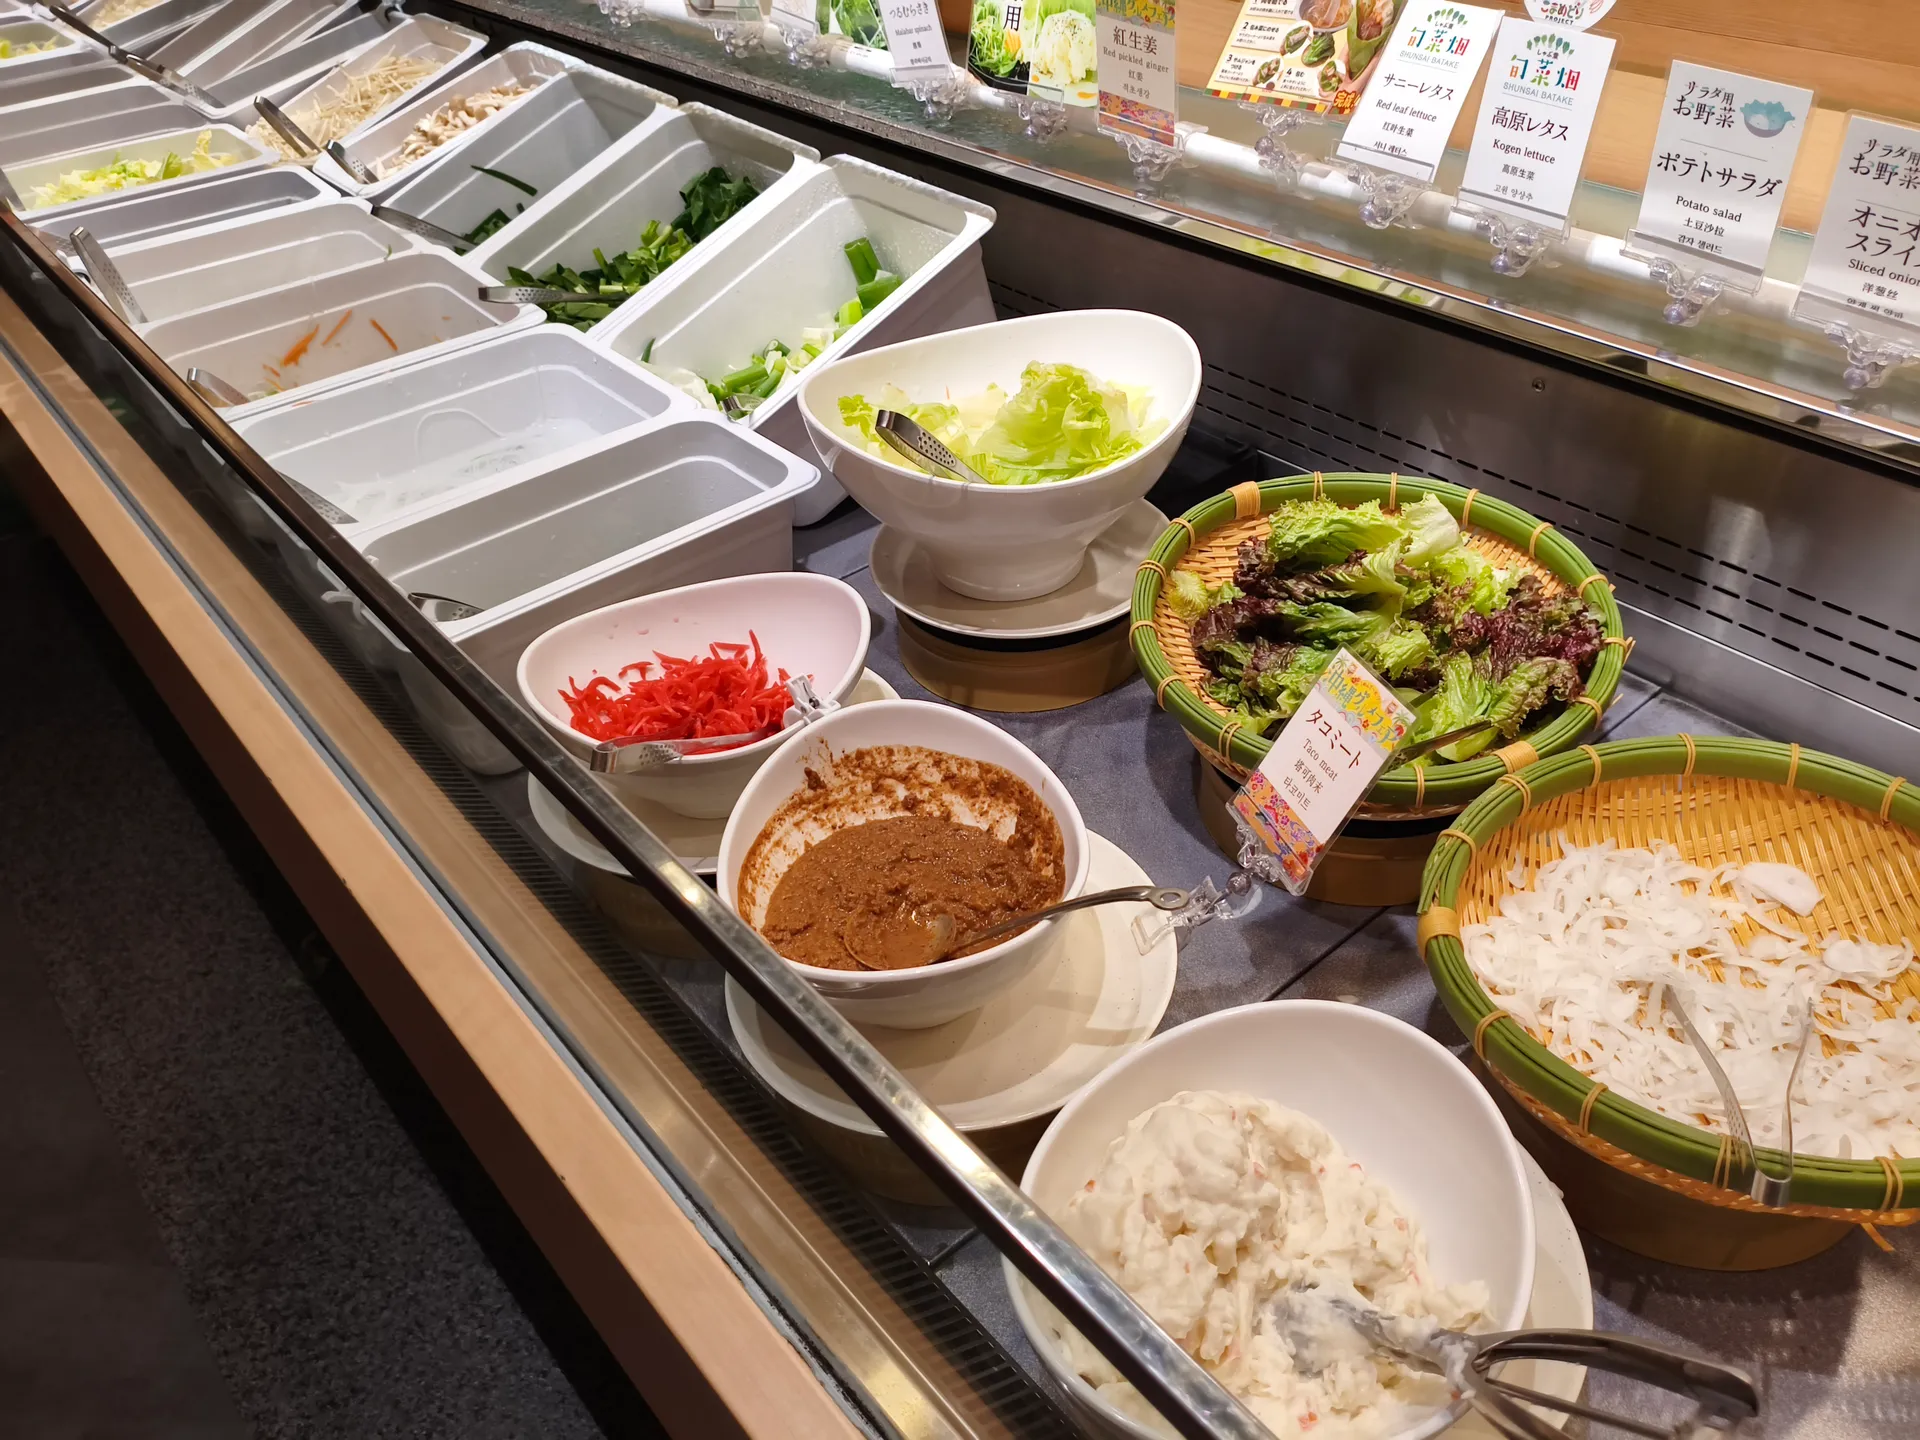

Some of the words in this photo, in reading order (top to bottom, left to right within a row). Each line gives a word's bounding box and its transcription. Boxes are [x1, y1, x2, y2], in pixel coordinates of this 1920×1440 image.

[1003, 5, 1021, 31] 用
[1545, 15, 1574, 26] PROJECT
[1113, 25, 1157, 55] 紅生姜
[1407, 26, 1470, 56] 旬菜畑
[1103, 46, 1116, 58] Red
[1118, 51, 1143, 66] pickled
[1146, 60, 1169, 73] ginger
[1227, 54, 1233, 62] 3
[1399, 50, 1430, 63] SHUNSAI
[1431, 56, 1460, 69] BATAKE
[1383, 74, 1454, 101] サニーレタス
[1509, 55, 1581, 91] 旬菜畑
[1503, 82, 1539, 97] SHUNSAI
[1541, 90, 1574, 106] BATAKE
[1376, 99, 1392, 110] Red
[1392, 102, 1409, 115] leaf
[1409, 106, 1437, 122] lettuce
[1491, 106, 1569, 142] 高原レタス
[1672, 95, 1736, 129] お野菜
[1492, 139, 1522, 157] Kogen
[1524, 147, 1556, 164] lettuce
[1502, 163, 1535, 181] 高原生菜
[1656, 152, 1783, 198] ポテトサラダ
[1849, 153, 1920, 190] お野菜
[1676, 195, 1710, 213] Potato
[1712, 206, 1743, 223] salad
[1848, 206, 1920, 241] オニオ
[1682, 217, 1725, 237] 土豆沙拉
[1845, 233, 1920, 268] スライ
[1848, 258, 1886, 277] Sliced
[1305, 708, 1363, 770] タコミート
[1302, 738, 1320, 761] Taco
[1319, 758, 1339, 782] meat
[1293, 759, 1324, 794] 塔可肉末
[1283, 776, 1312, 811] 타코미트
